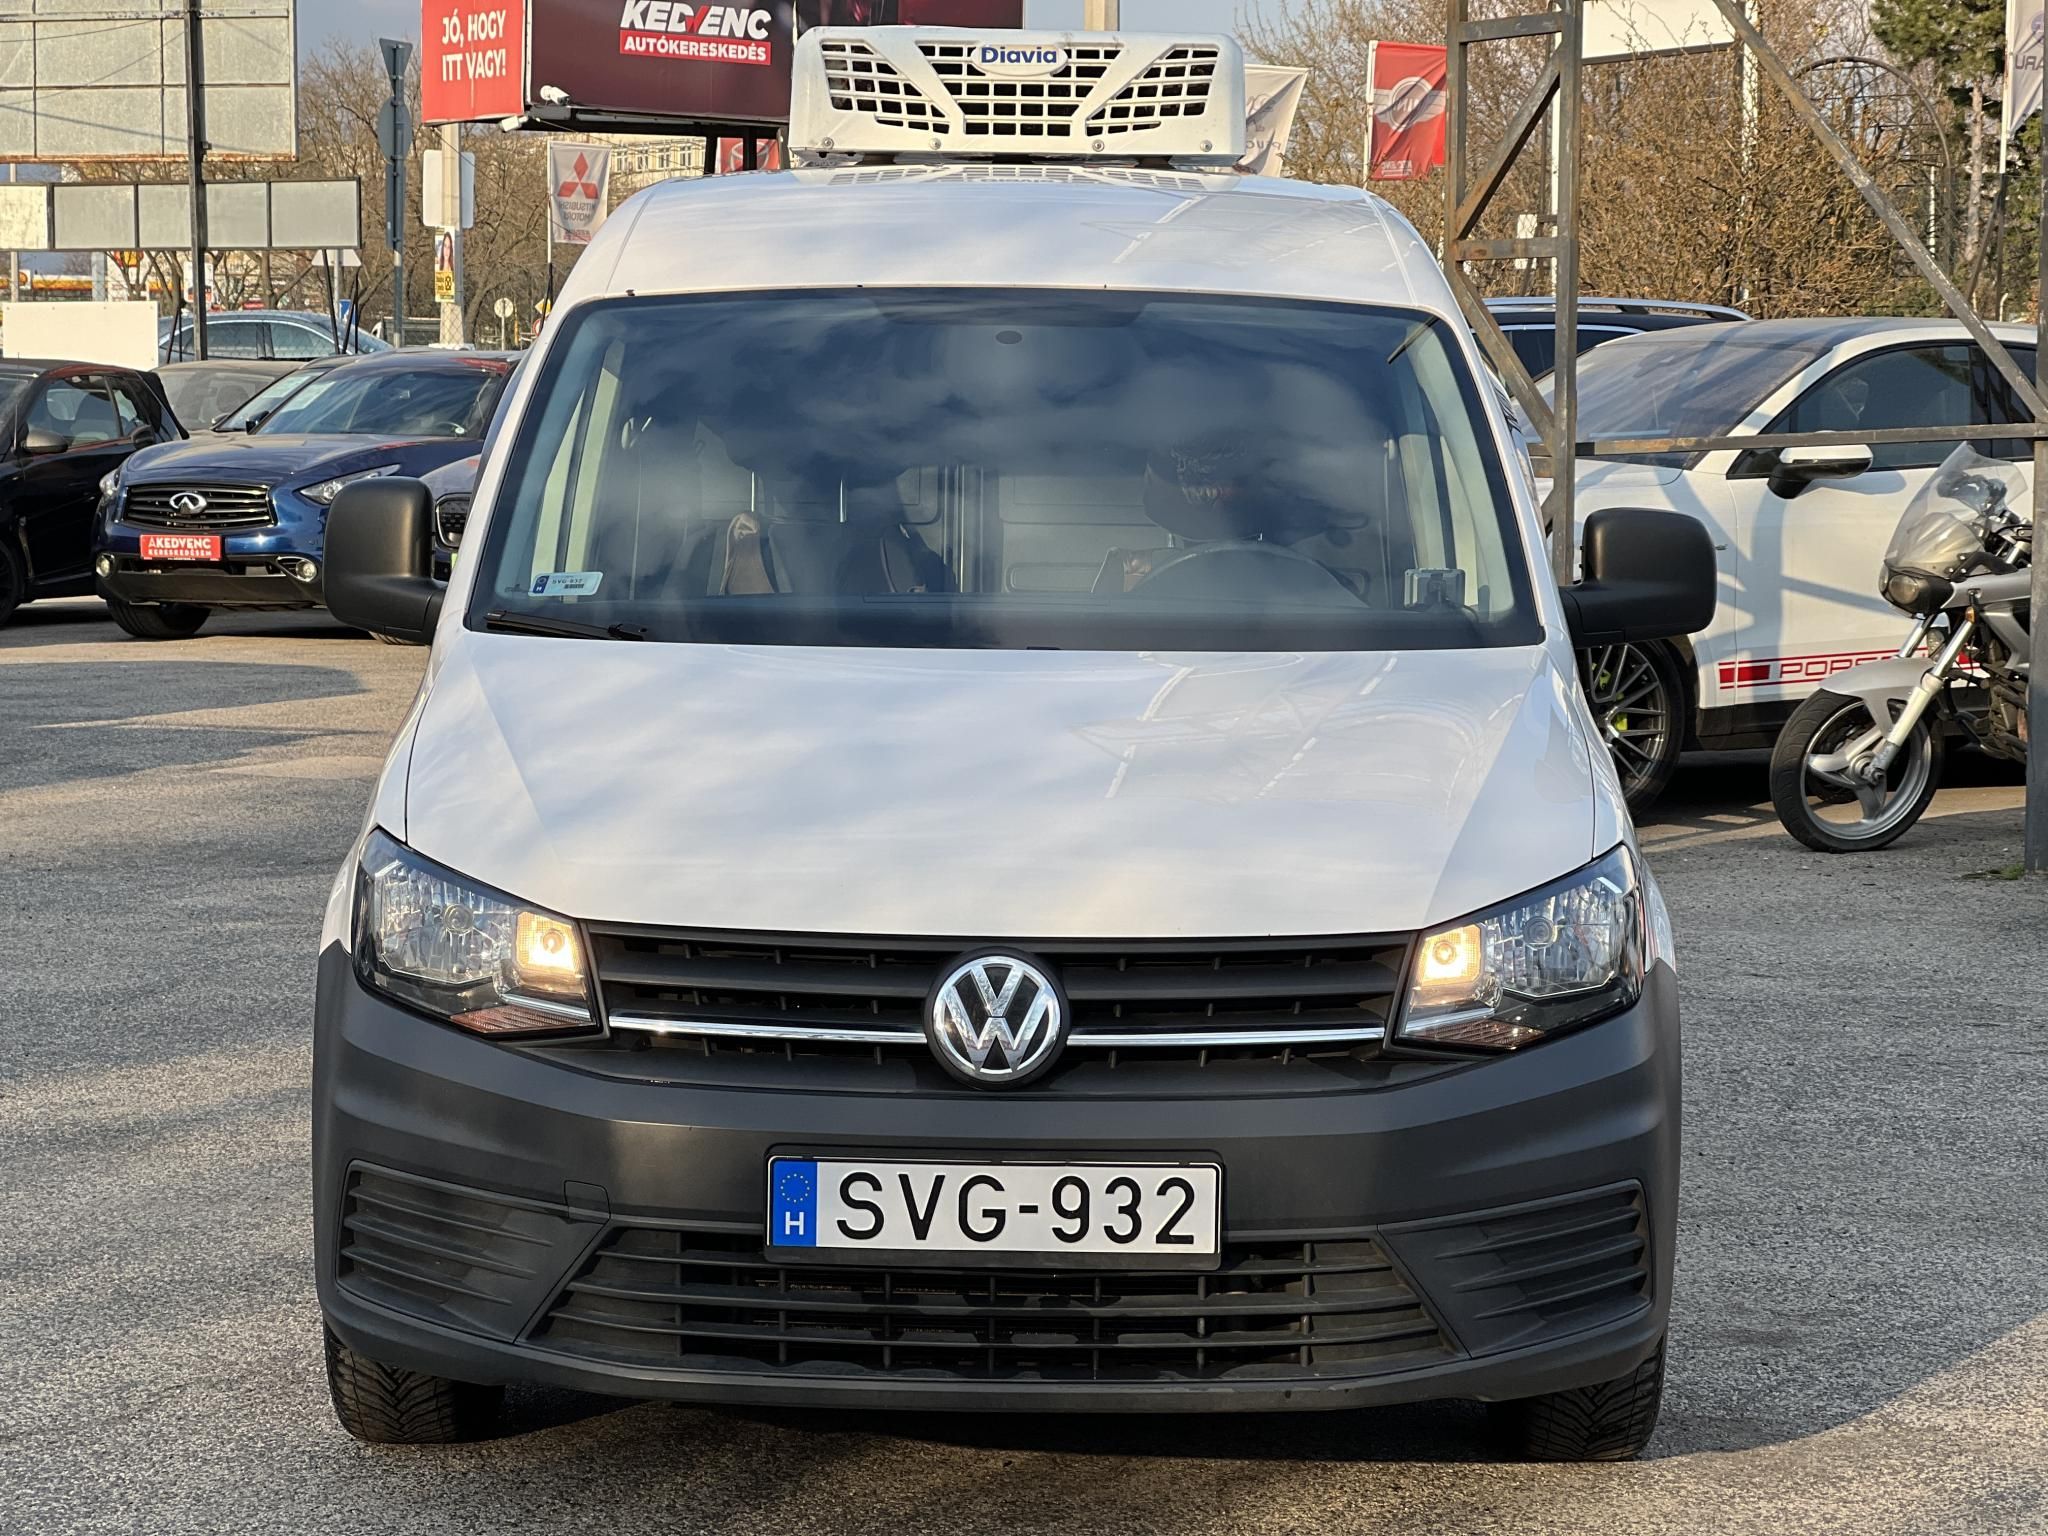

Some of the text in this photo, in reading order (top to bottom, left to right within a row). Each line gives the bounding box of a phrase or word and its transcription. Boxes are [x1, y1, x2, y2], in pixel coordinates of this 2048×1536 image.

[441, 8, 506, 48] JÓ, HOGY
[624, 35, 767, 61] AUTÓKERESKEDÉS
[981, 46, 1057, 63] Diavia
[442, 48, 506, 81] ITT VAGY!
[836, 1171, 1195, 1245] SVG-932
[785, 1211, 805, 1236] H
